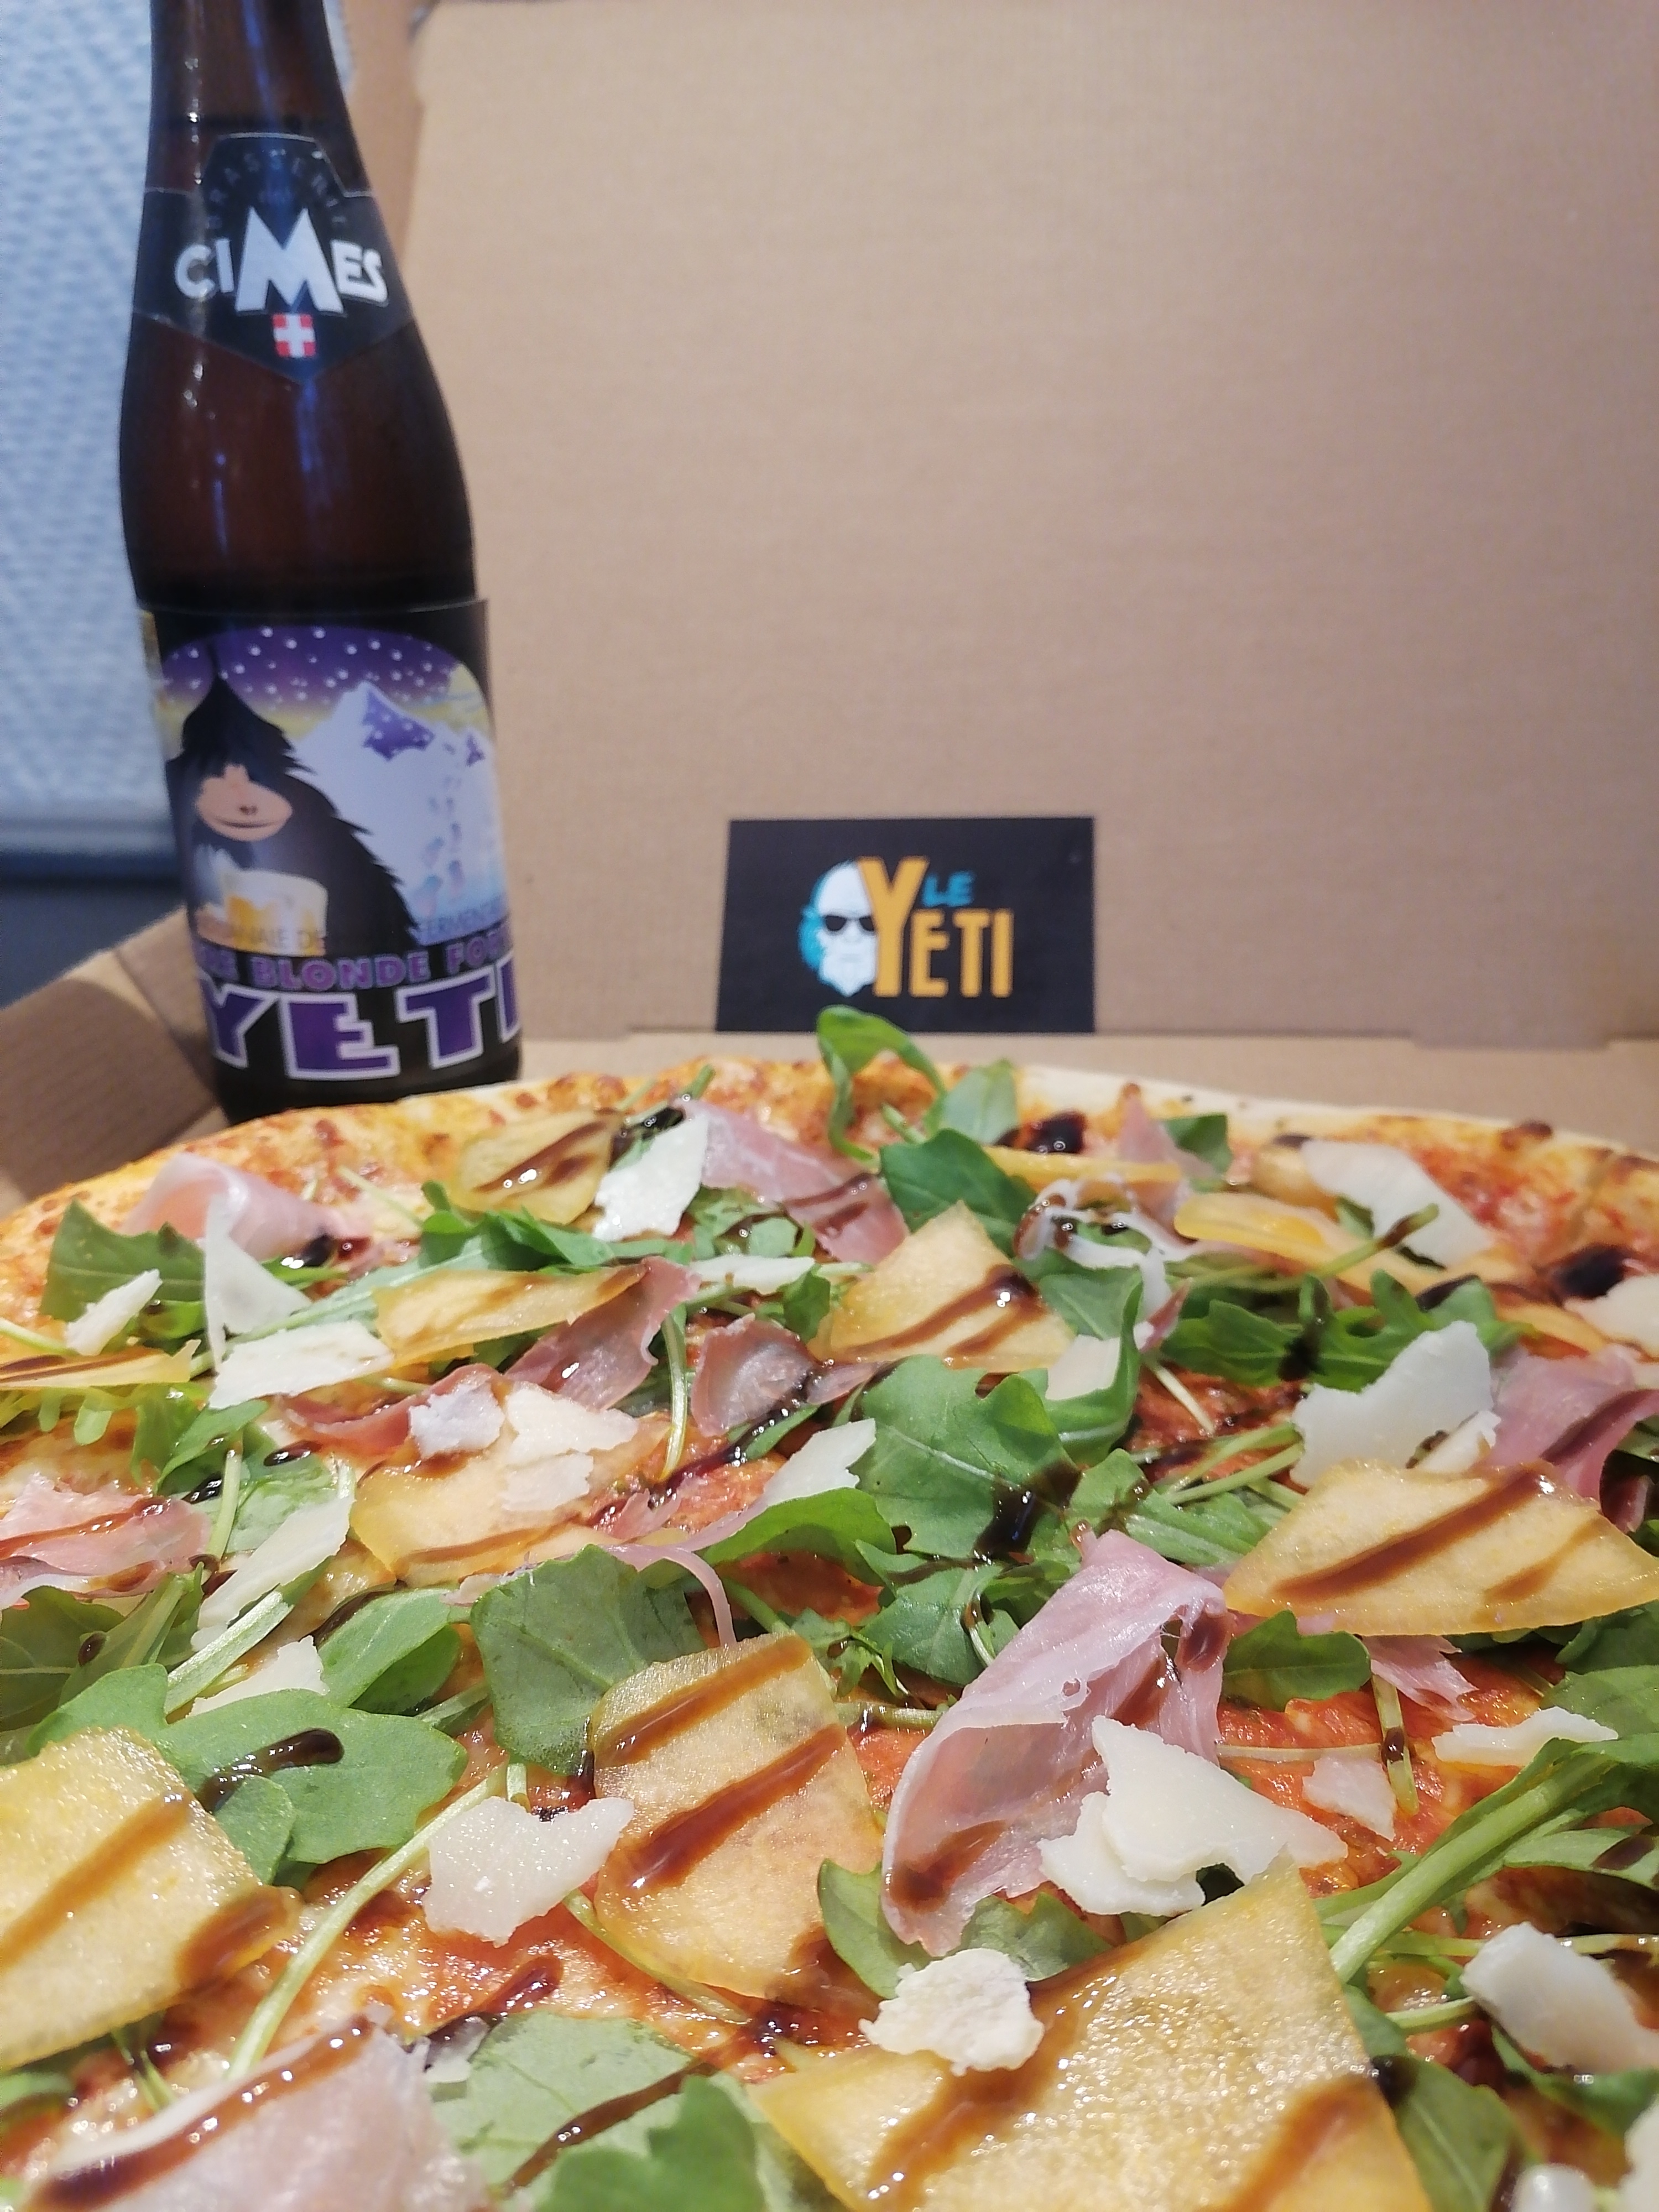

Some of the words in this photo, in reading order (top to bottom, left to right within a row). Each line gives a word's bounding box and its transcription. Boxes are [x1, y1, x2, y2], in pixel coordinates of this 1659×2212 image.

[174, 205, 389, 316] CIMES
[855, 855, 1014, 998] YETI
[921, 870, 977, 907] LE
[197, 952, 521, 1081] YETI
[249, 950, 431, 991] BLONDE
